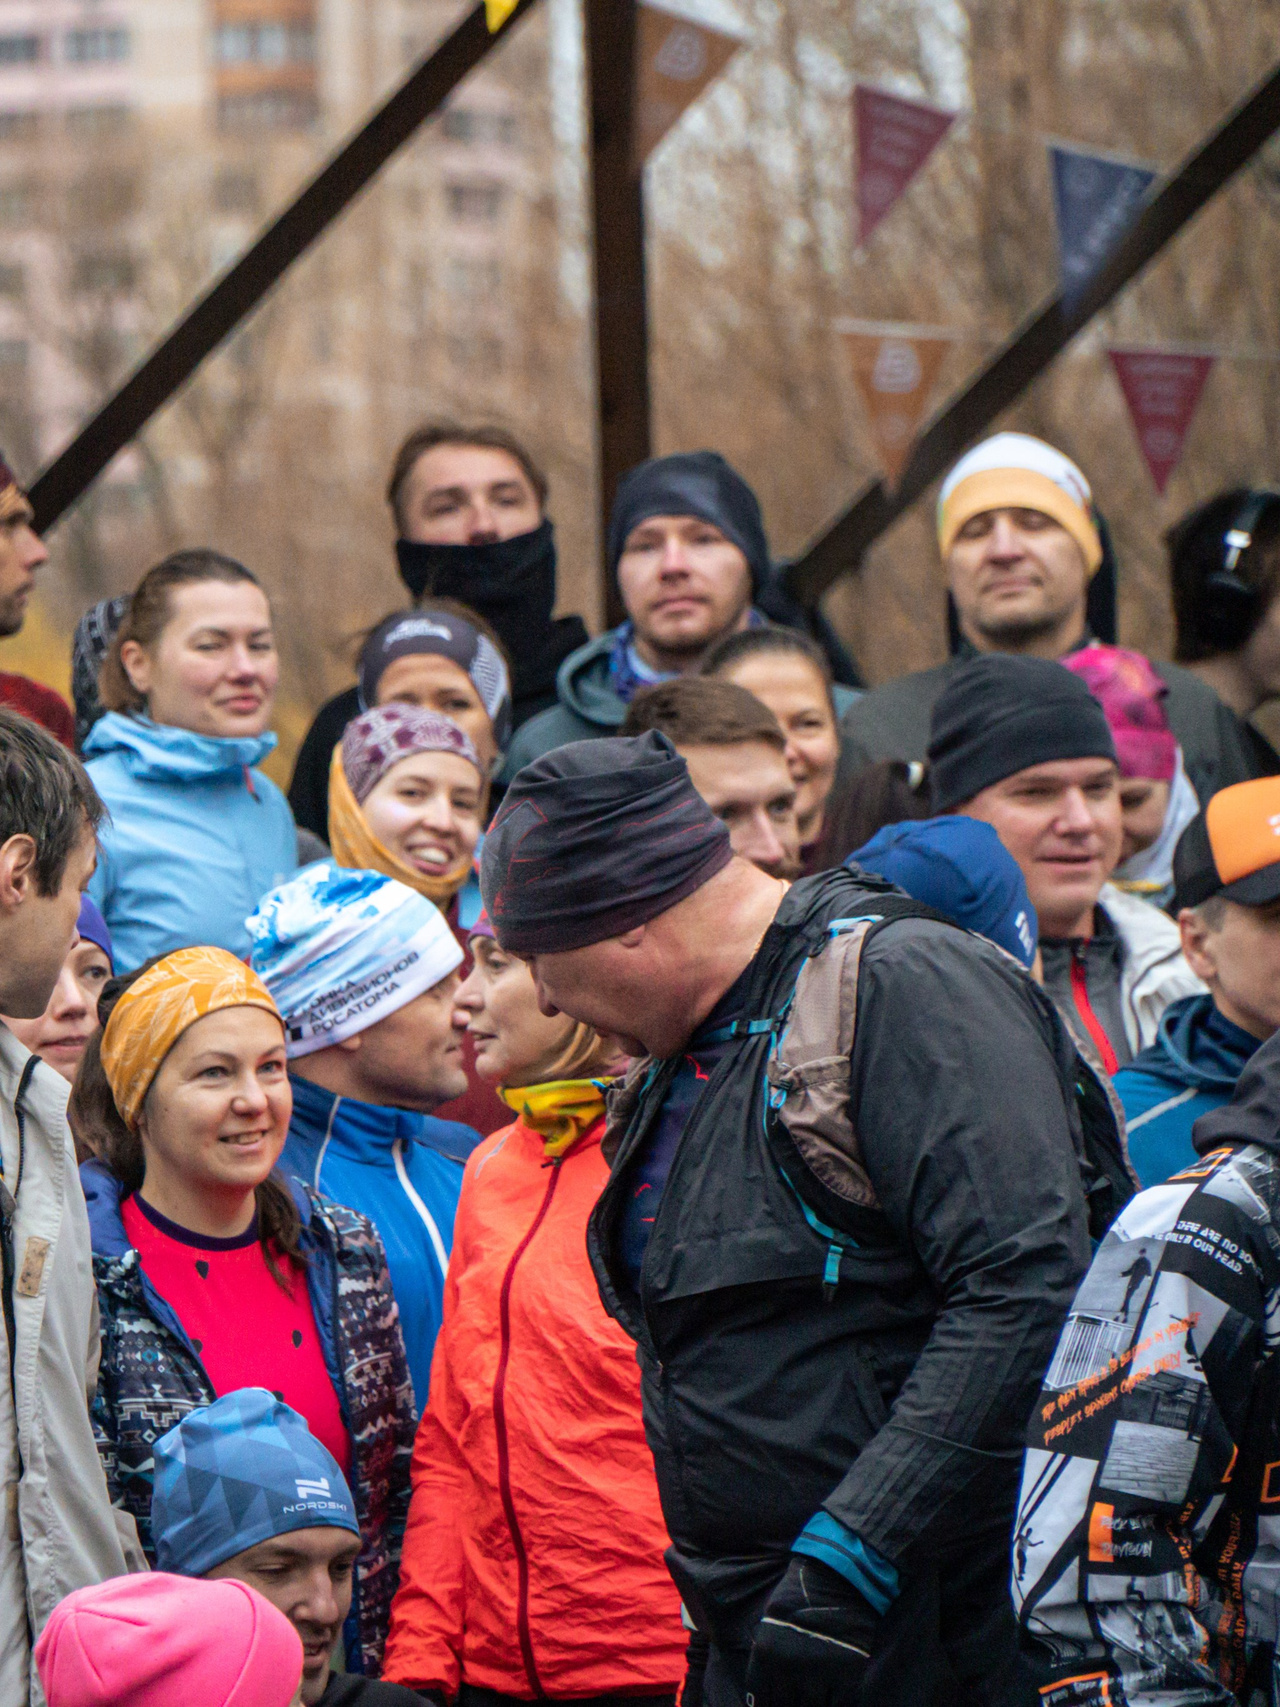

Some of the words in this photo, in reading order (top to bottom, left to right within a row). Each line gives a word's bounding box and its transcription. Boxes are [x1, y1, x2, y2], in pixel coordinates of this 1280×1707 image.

[311, 981, 401, 1035] РОСАТОМА
[1193, 1239, 1215, 1255] OUR
[1222, 1238, 1239, 1253] NO
[282, 1501, 347, 1514] NORDSKI
